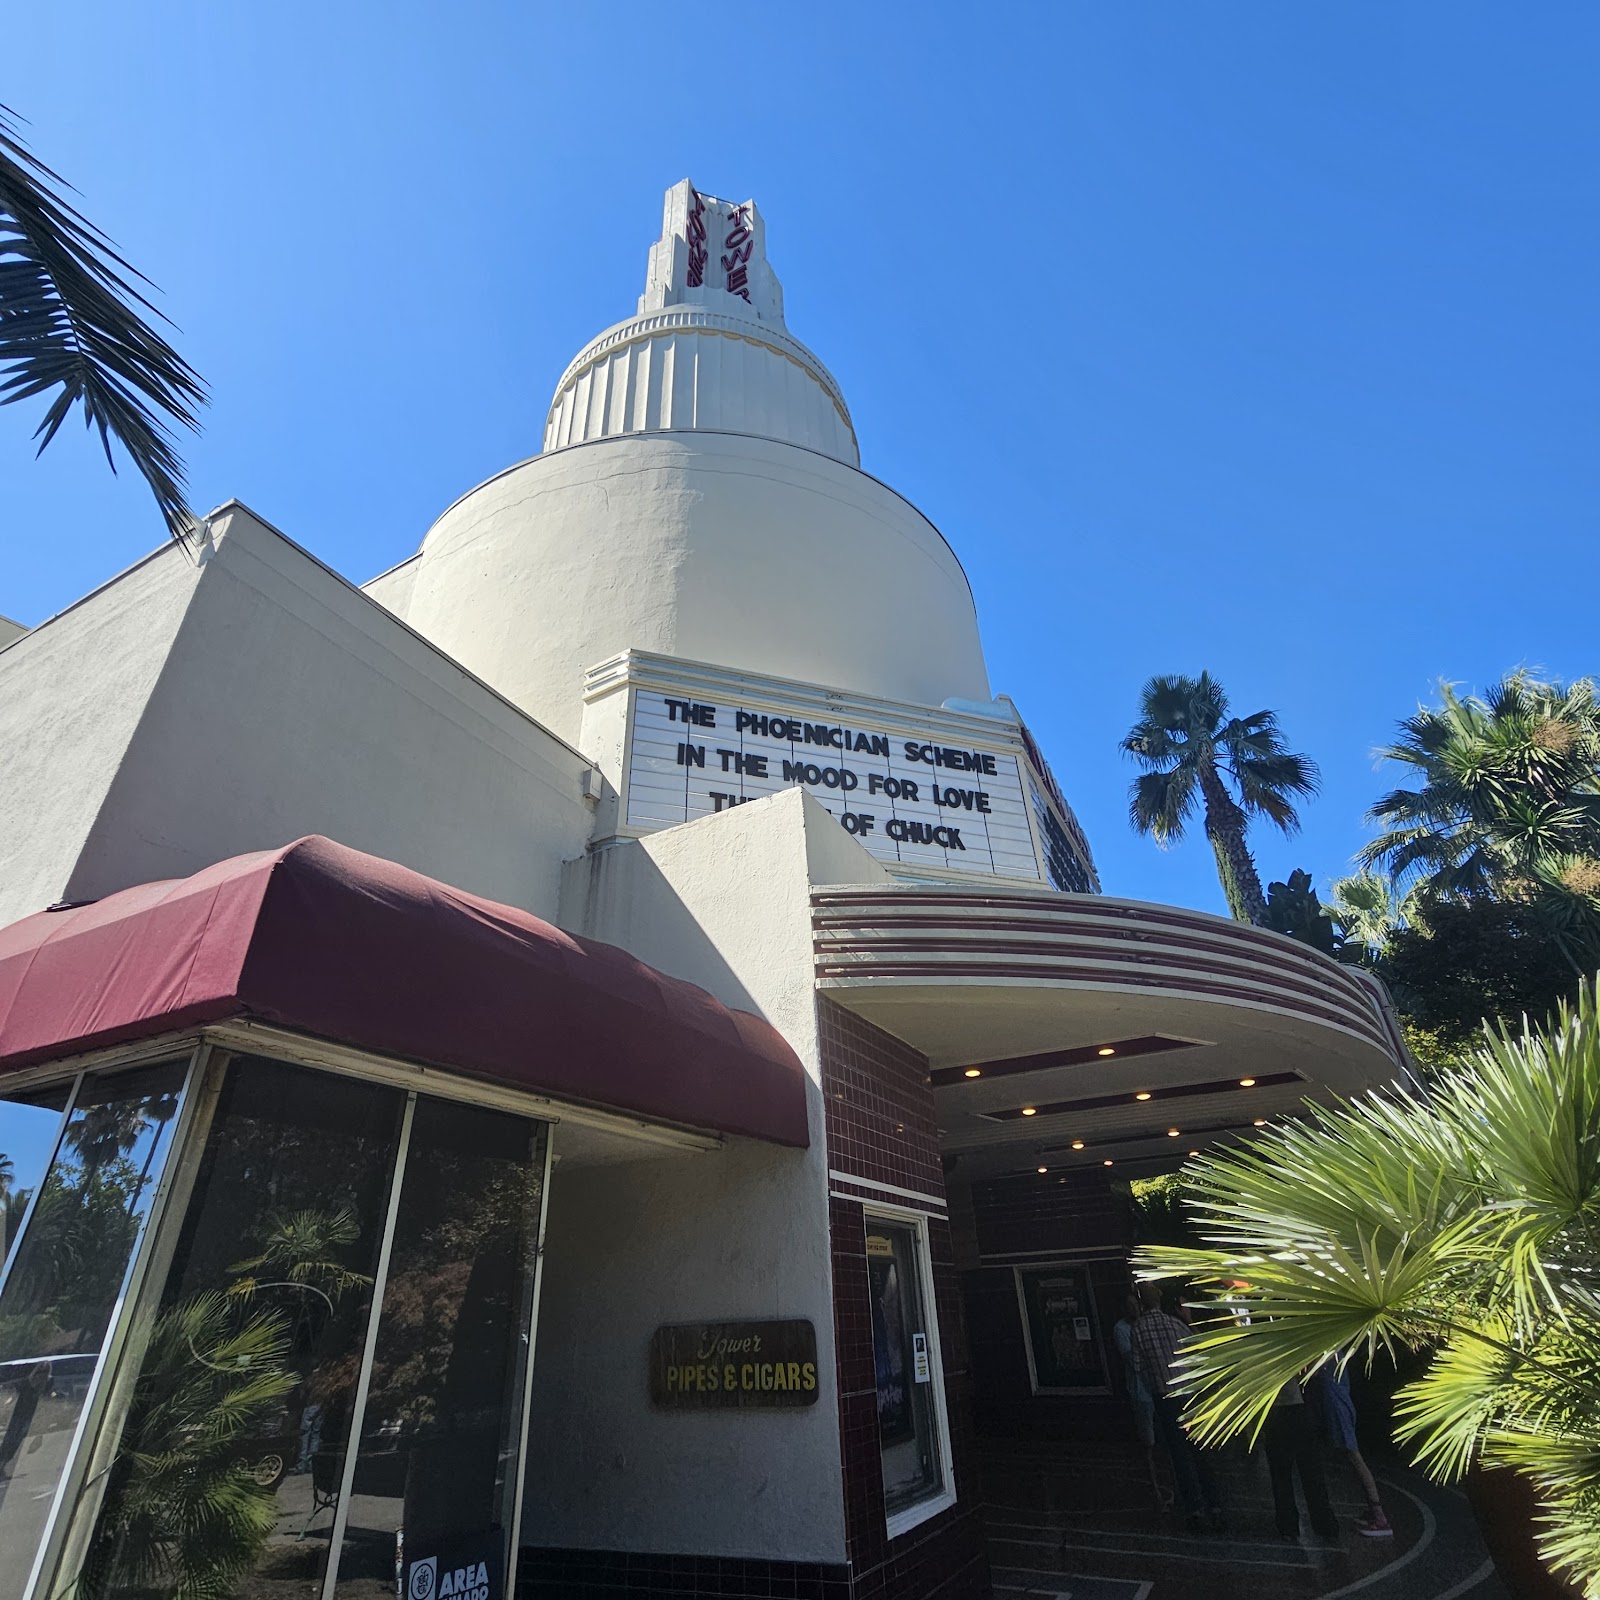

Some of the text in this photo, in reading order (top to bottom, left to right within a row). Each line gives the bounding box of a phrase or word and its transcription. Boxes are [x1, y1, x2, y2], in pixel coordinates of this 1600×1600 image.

[721, 205, 753, 305] TOWER
[664, 698, 998, 776] THE PHOENICIAN SCHEME
[677, 742, 992, 814] IN THE MOOD FOR LOVE
[841, 812, 874, 836] OF
[885, 818, 966, 851] CHUCK
[697, 1330, 762, 1360] Tower
[667, 1362, 816, 1392] PIPES & CIGARS
[438, 1561, 489, 1599] AREA
